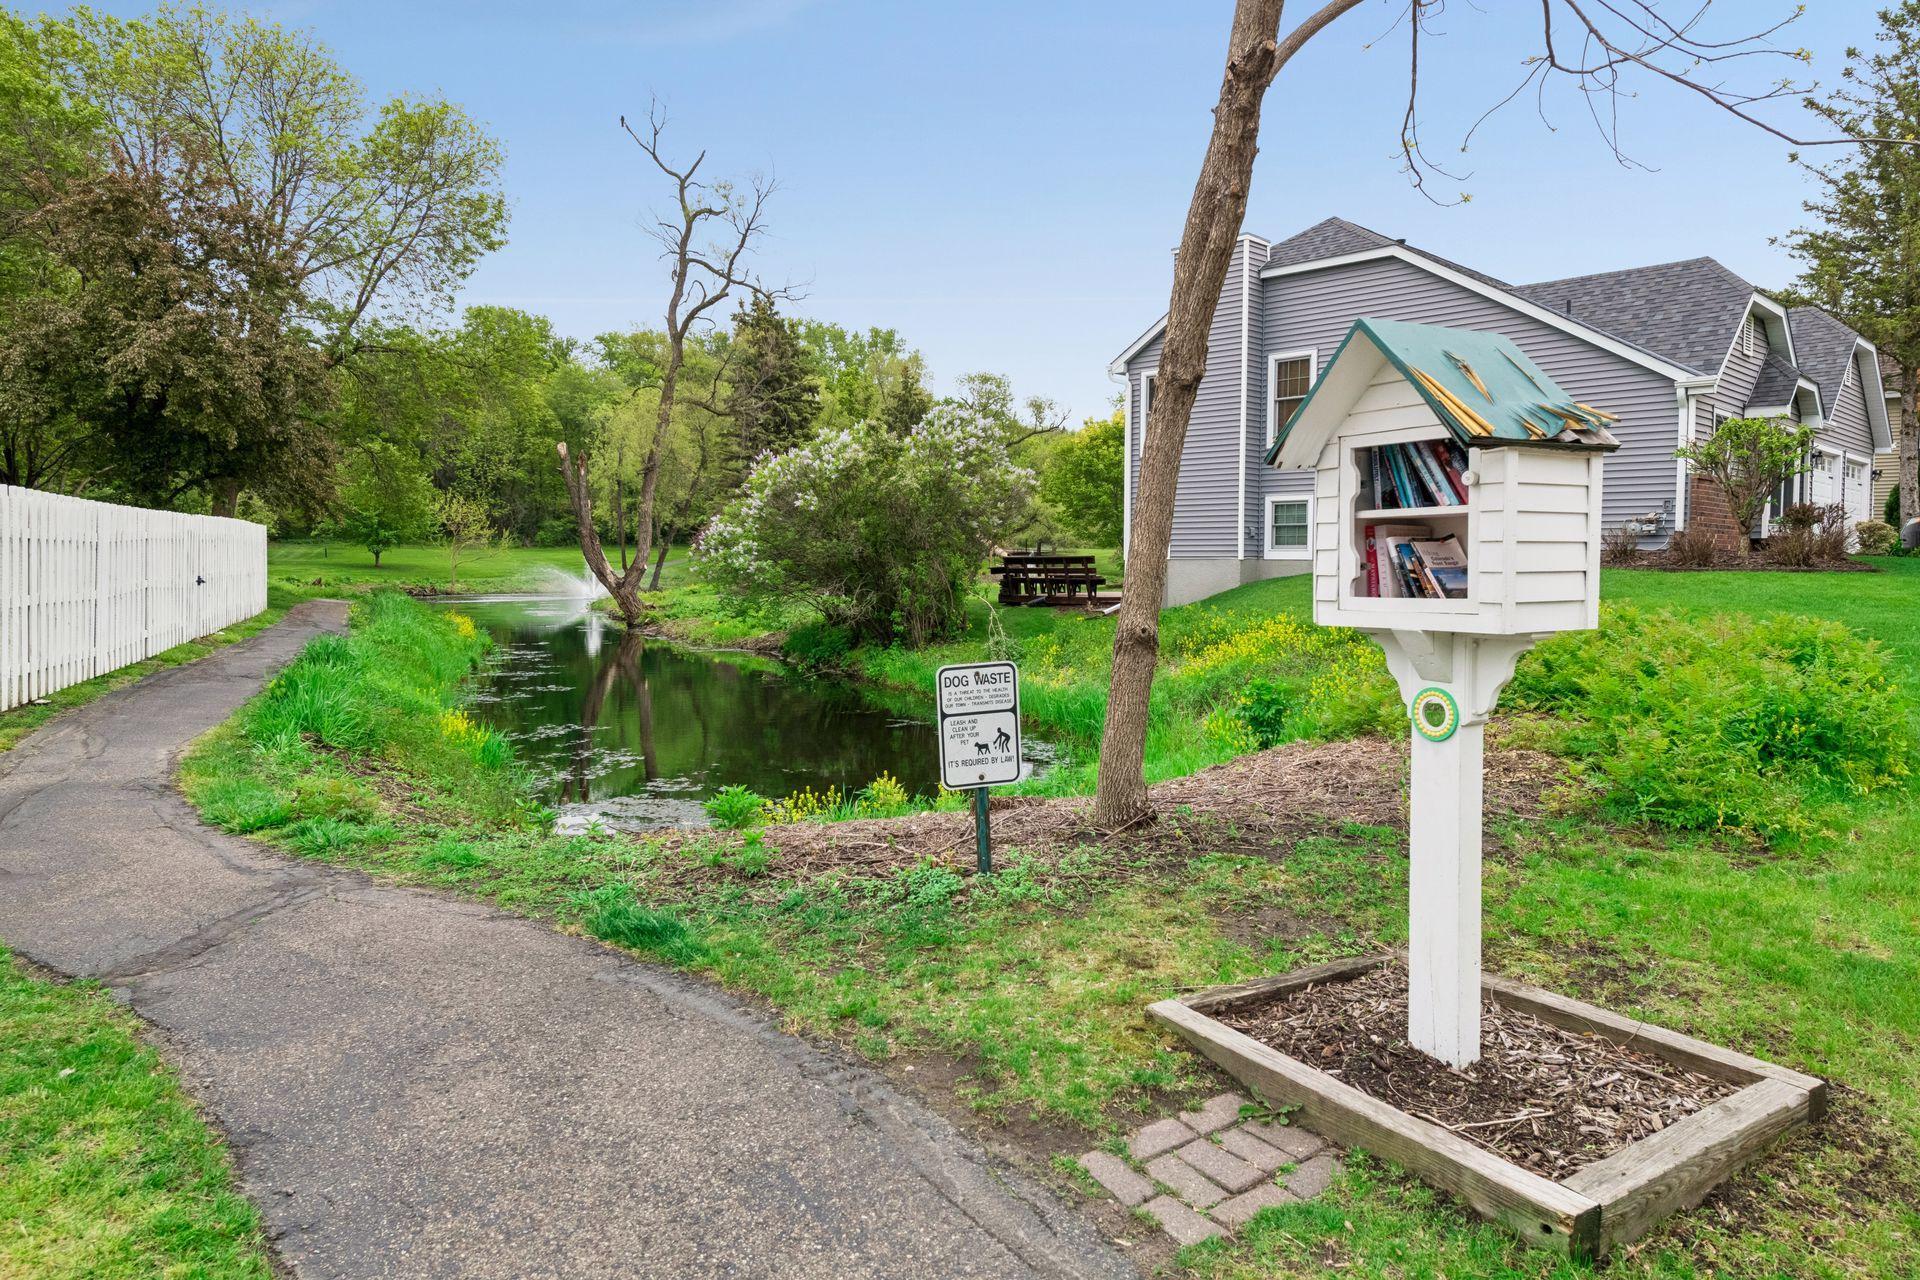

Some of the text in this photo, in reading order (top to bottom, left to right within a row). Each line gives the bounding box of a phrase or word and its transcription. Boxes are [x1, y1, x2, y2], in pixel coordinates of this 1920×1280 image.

[944, 672, 1011, 688] DOG WASTE
[962, 758, 989, 766] REQUIRED
